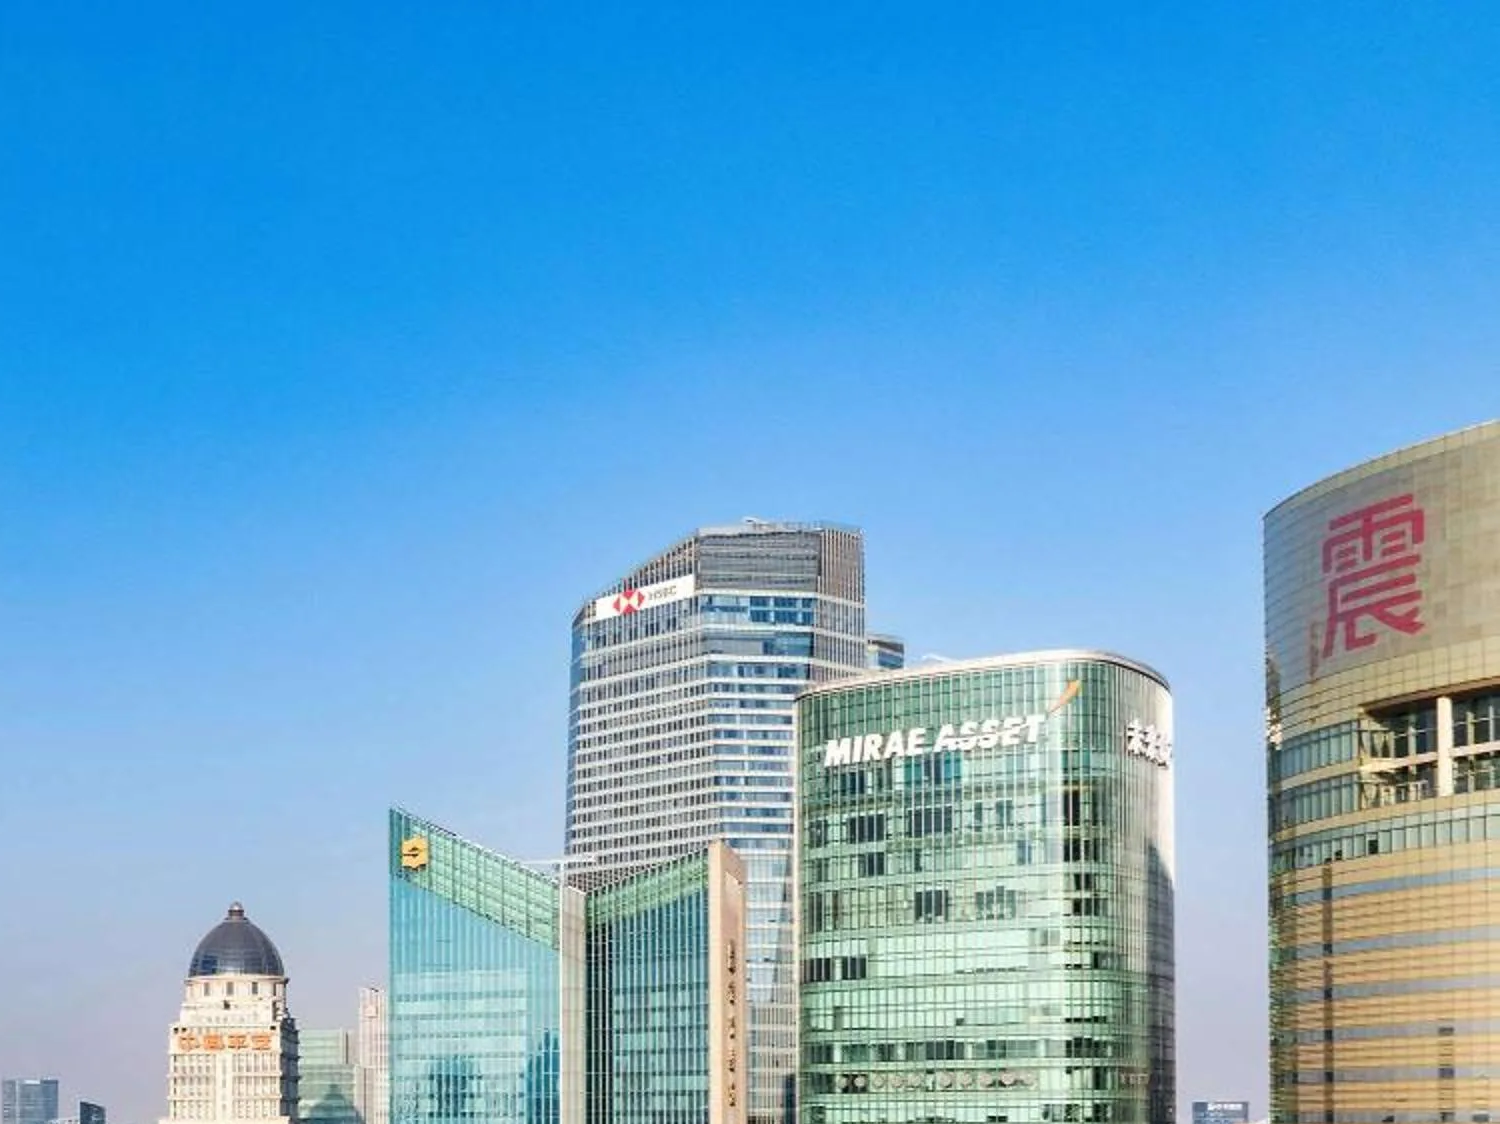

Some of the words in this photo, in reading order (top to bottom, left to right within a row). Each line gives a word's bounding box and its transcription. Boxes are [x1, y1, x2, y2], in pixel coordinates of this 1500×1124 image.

[1320, 492, 1426, 659] 震
[823, 727, 927, 767] MIRAE
[933, 713, 1046, 753] ASSET
